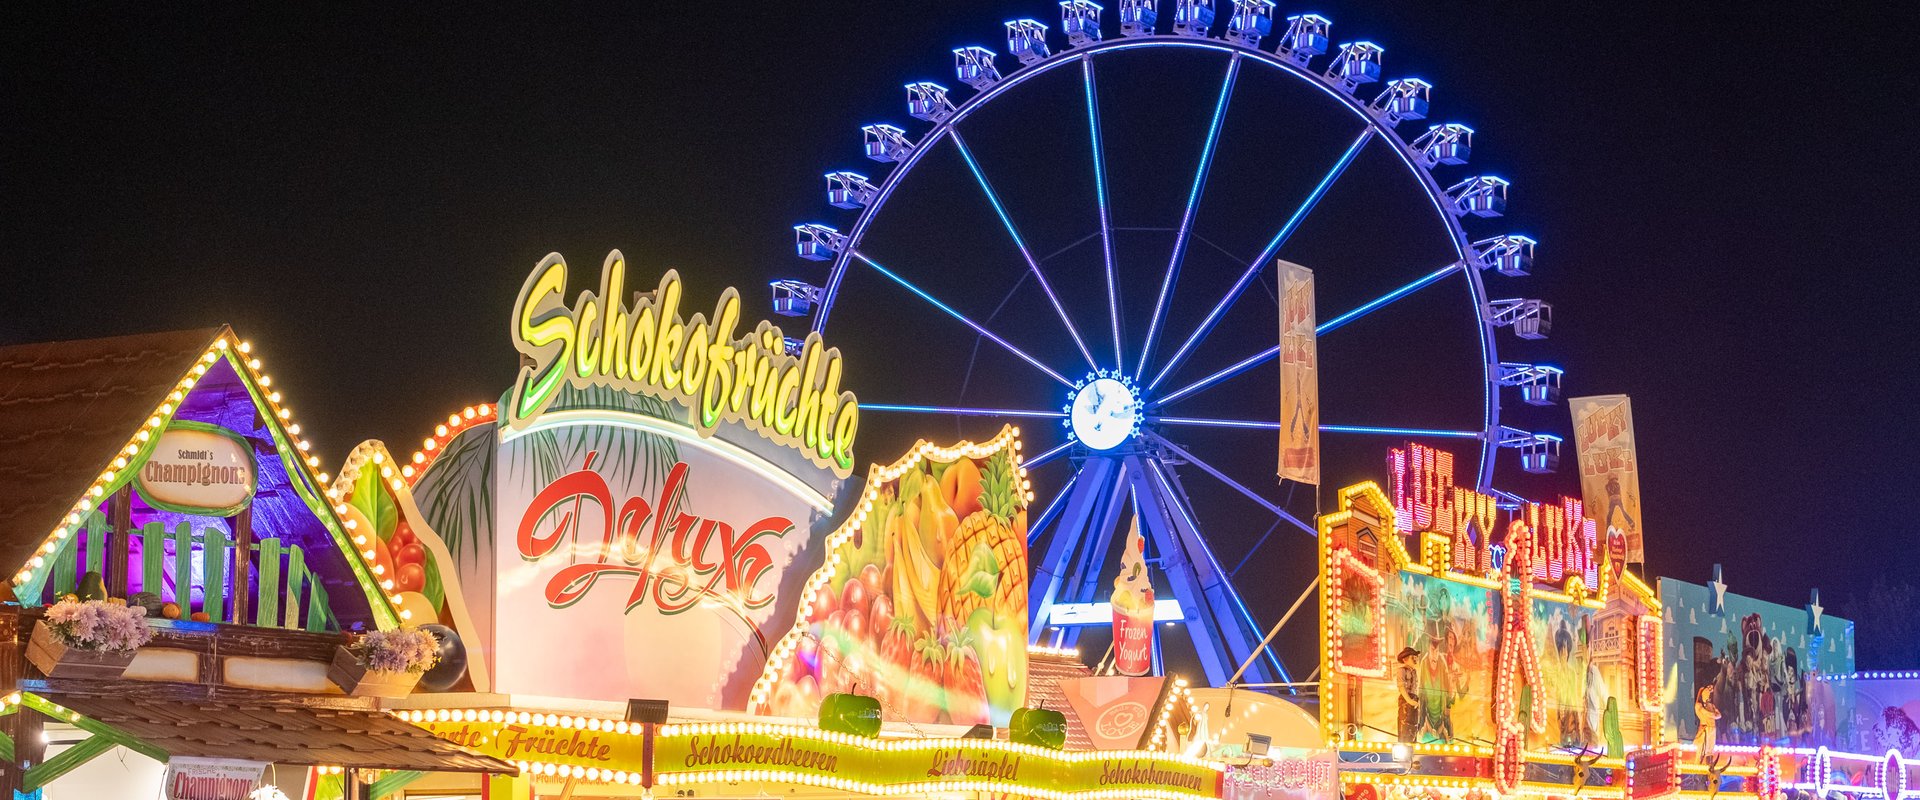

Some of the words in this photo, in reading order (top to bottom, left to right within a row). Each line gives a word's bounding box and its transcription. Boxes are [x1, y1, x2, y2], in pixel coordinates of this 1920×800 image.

[517, 257, 858, 470] Schokofrüchte
[1577, 401, 1627, 455] LUCKY
[145, 460, 246, 487] Champignons
[516, 450, 795, 615] Deluxe
[1392, 441, 1498, 575] LUCKY
[1528, 495, 1599, 593] LUKE
[1118, 640, 1148, 670] Yogurt
[1119, 618, 1149, 641] Frozen
[495, 724, 612, 762] Früchte
[684, 734, 838, 773] Schokoerdbeeren
[926, 748, 1021, 782] Liebesäpfel
[1099, 759, 1203, 792] Schokobananen
